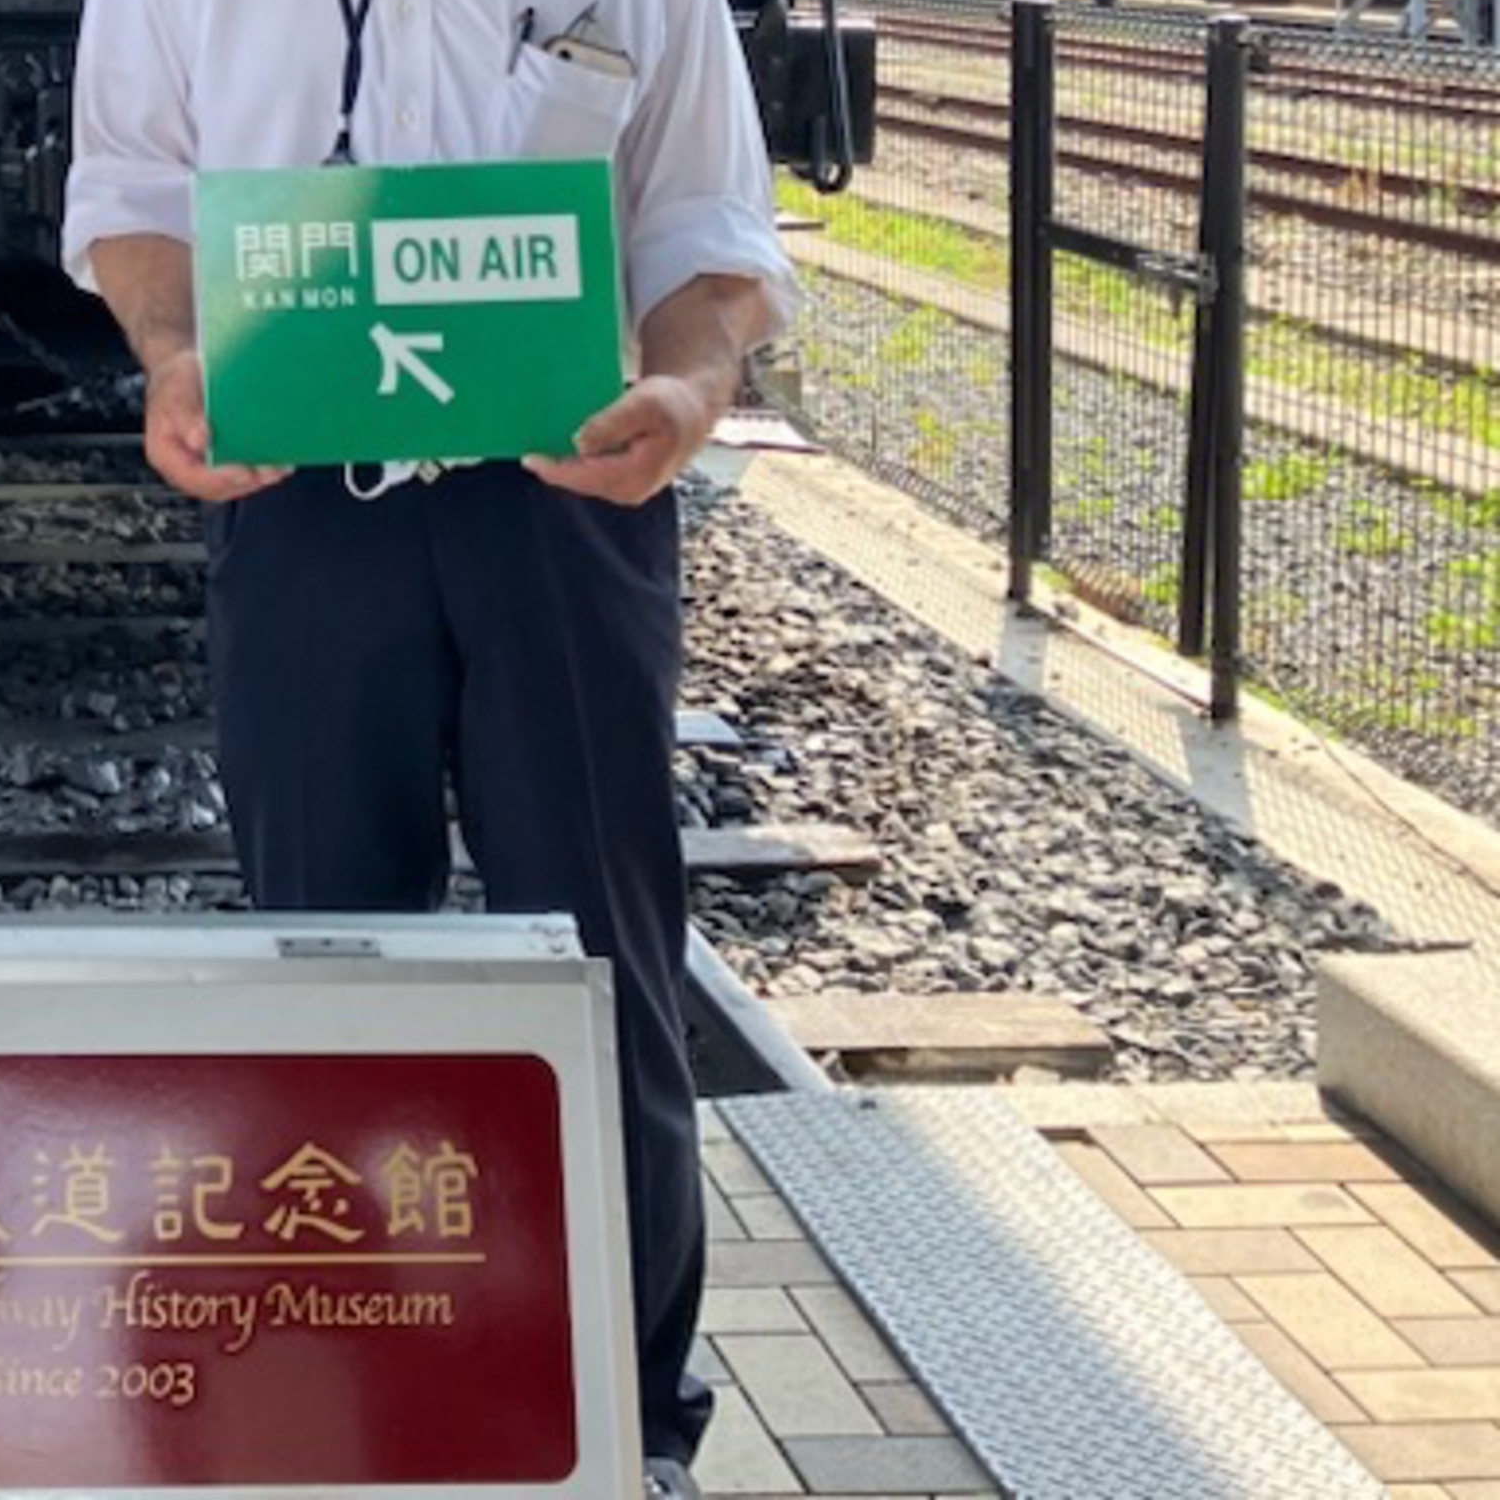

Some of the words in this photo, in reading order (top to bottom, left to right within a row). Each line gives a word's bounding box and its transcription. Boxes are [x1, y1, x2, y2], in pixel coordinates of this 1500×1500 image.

[234, 221, 359, 282] 関門
[392, 236, 461, 284] ON
[478, 234, 558, 281] AIR
[102, 1270, 258, 1353] History
[266, 1282, 454, 1326] Museum
[95, 1362, 196, 1407] 2003
